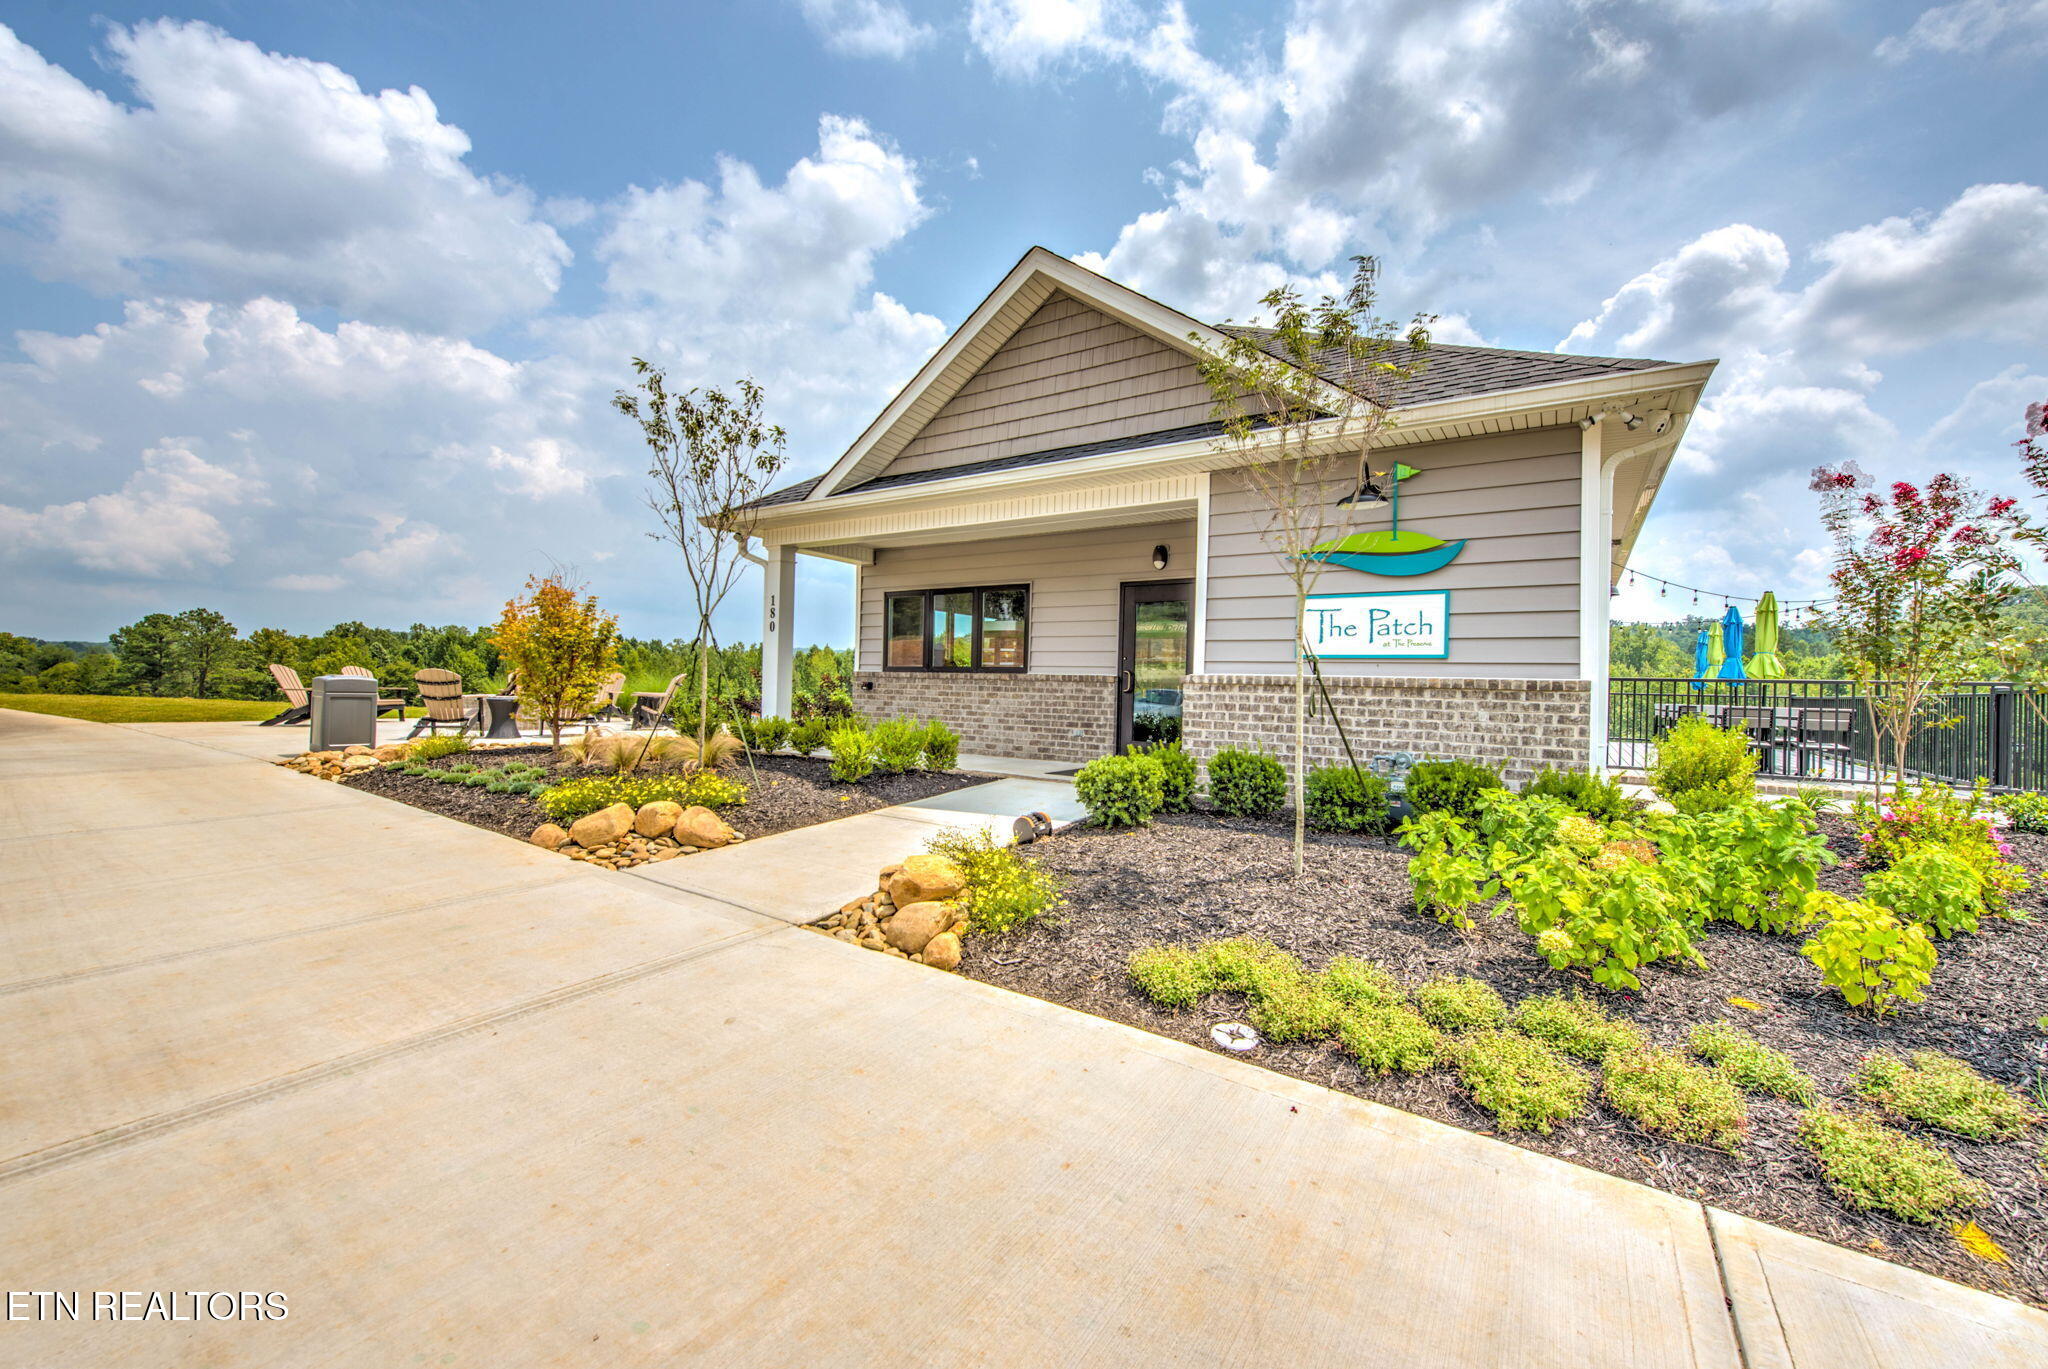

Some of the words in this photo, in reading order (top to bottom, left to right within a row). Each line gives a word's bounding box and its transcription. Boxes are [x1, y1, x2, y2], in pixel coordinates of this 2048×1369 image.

[1306, 608, 1357, 644] The
[1369, 608, 1432, 644] Patch
[1392, 639, 1405, 648] The
